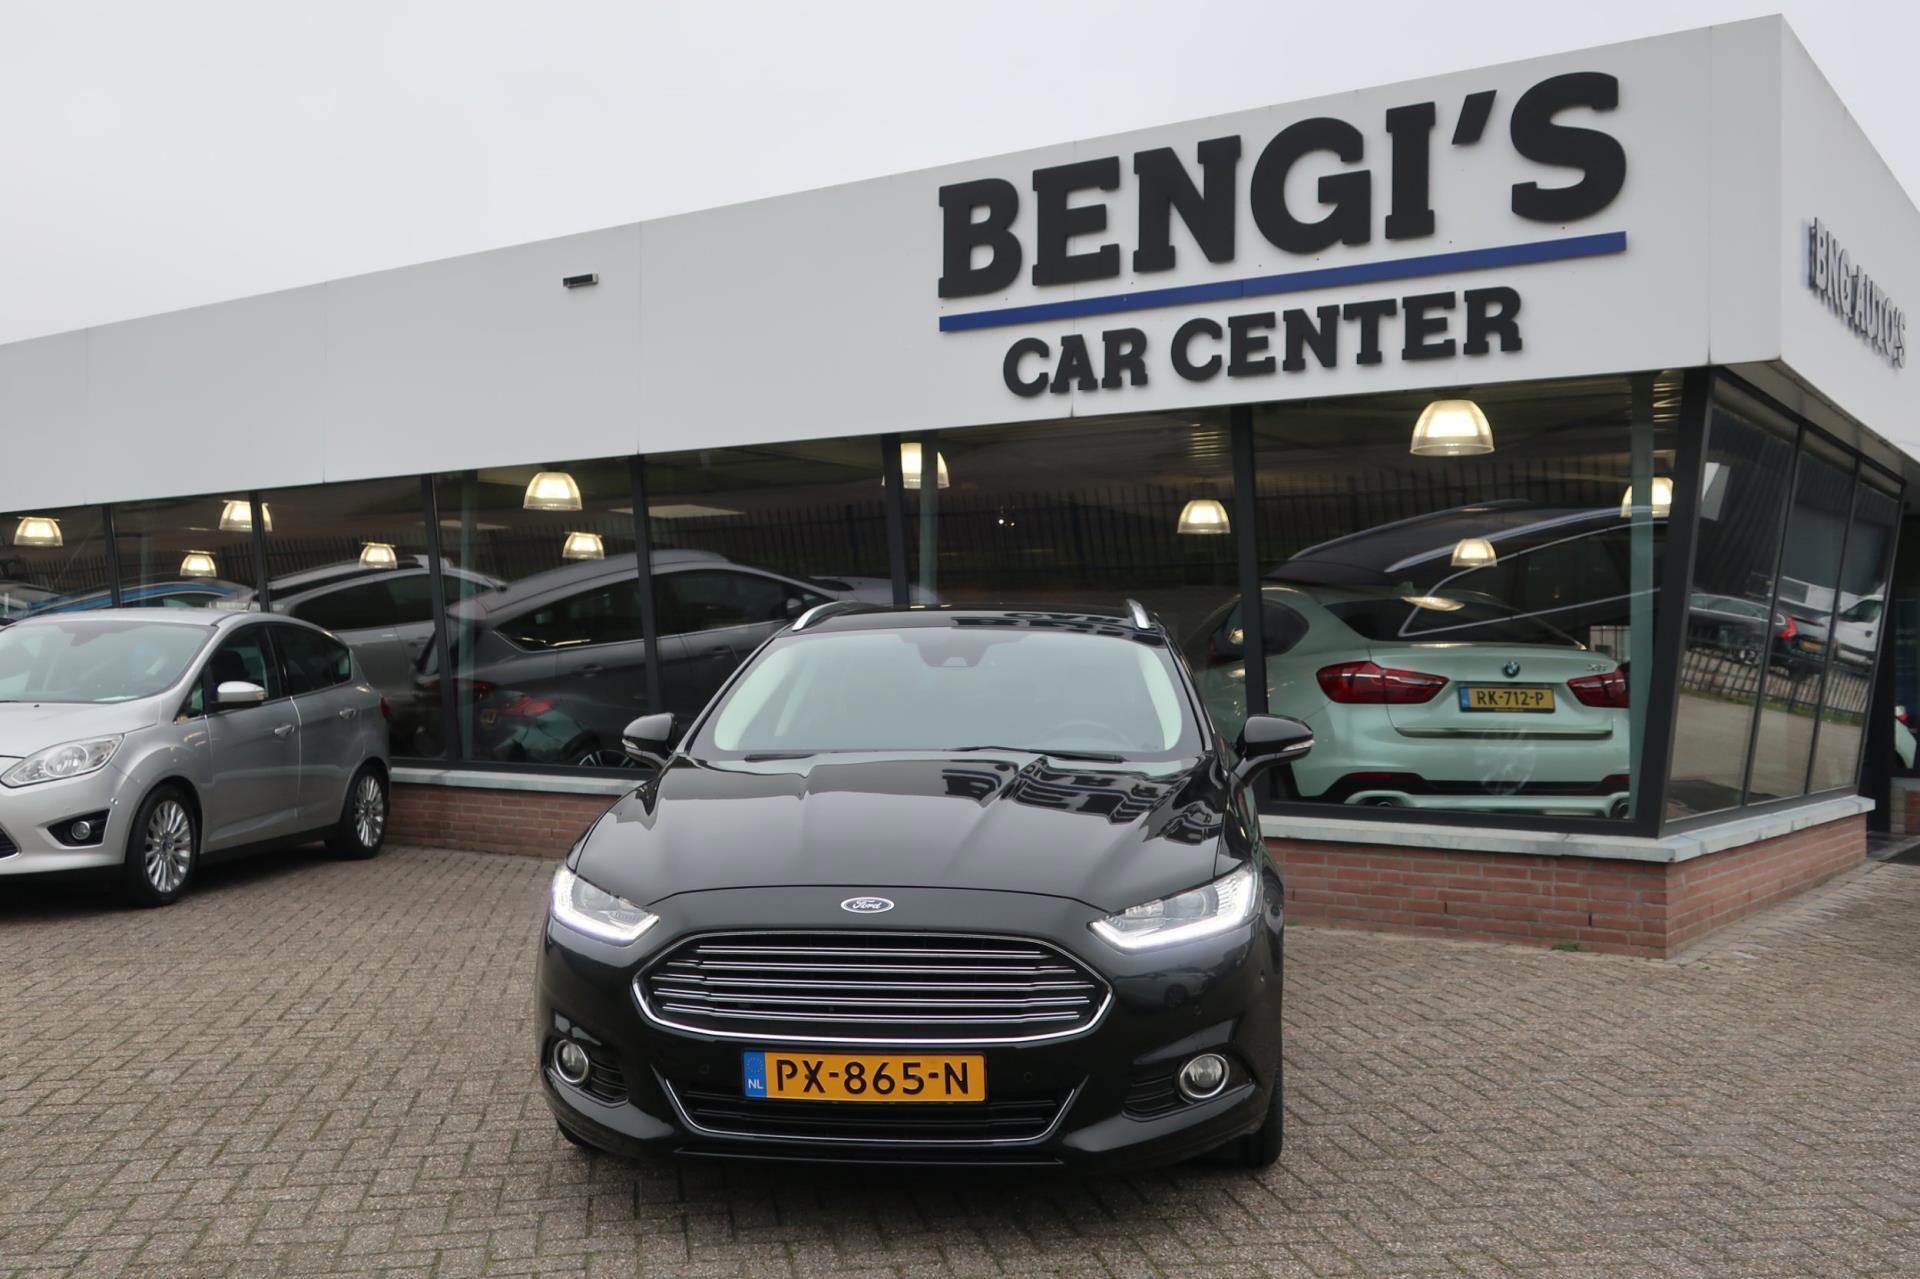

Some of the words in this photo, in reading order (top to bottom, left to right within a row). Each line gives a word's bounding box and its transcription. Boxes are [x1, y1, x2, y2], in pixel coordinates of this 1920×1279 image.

[938, 72, 1627, 298] BENGI'S
[1810, 217, 1852, 319] BNG
[1003, 328, 1148, 398] CAR
[1171, 286, 1523, 381] CENTER
[1476, 690, 1544, 706] RK-712-P
[747, 1078, 764, 1090] NL
[775, 1059, 969, 1096] PX-865-N
